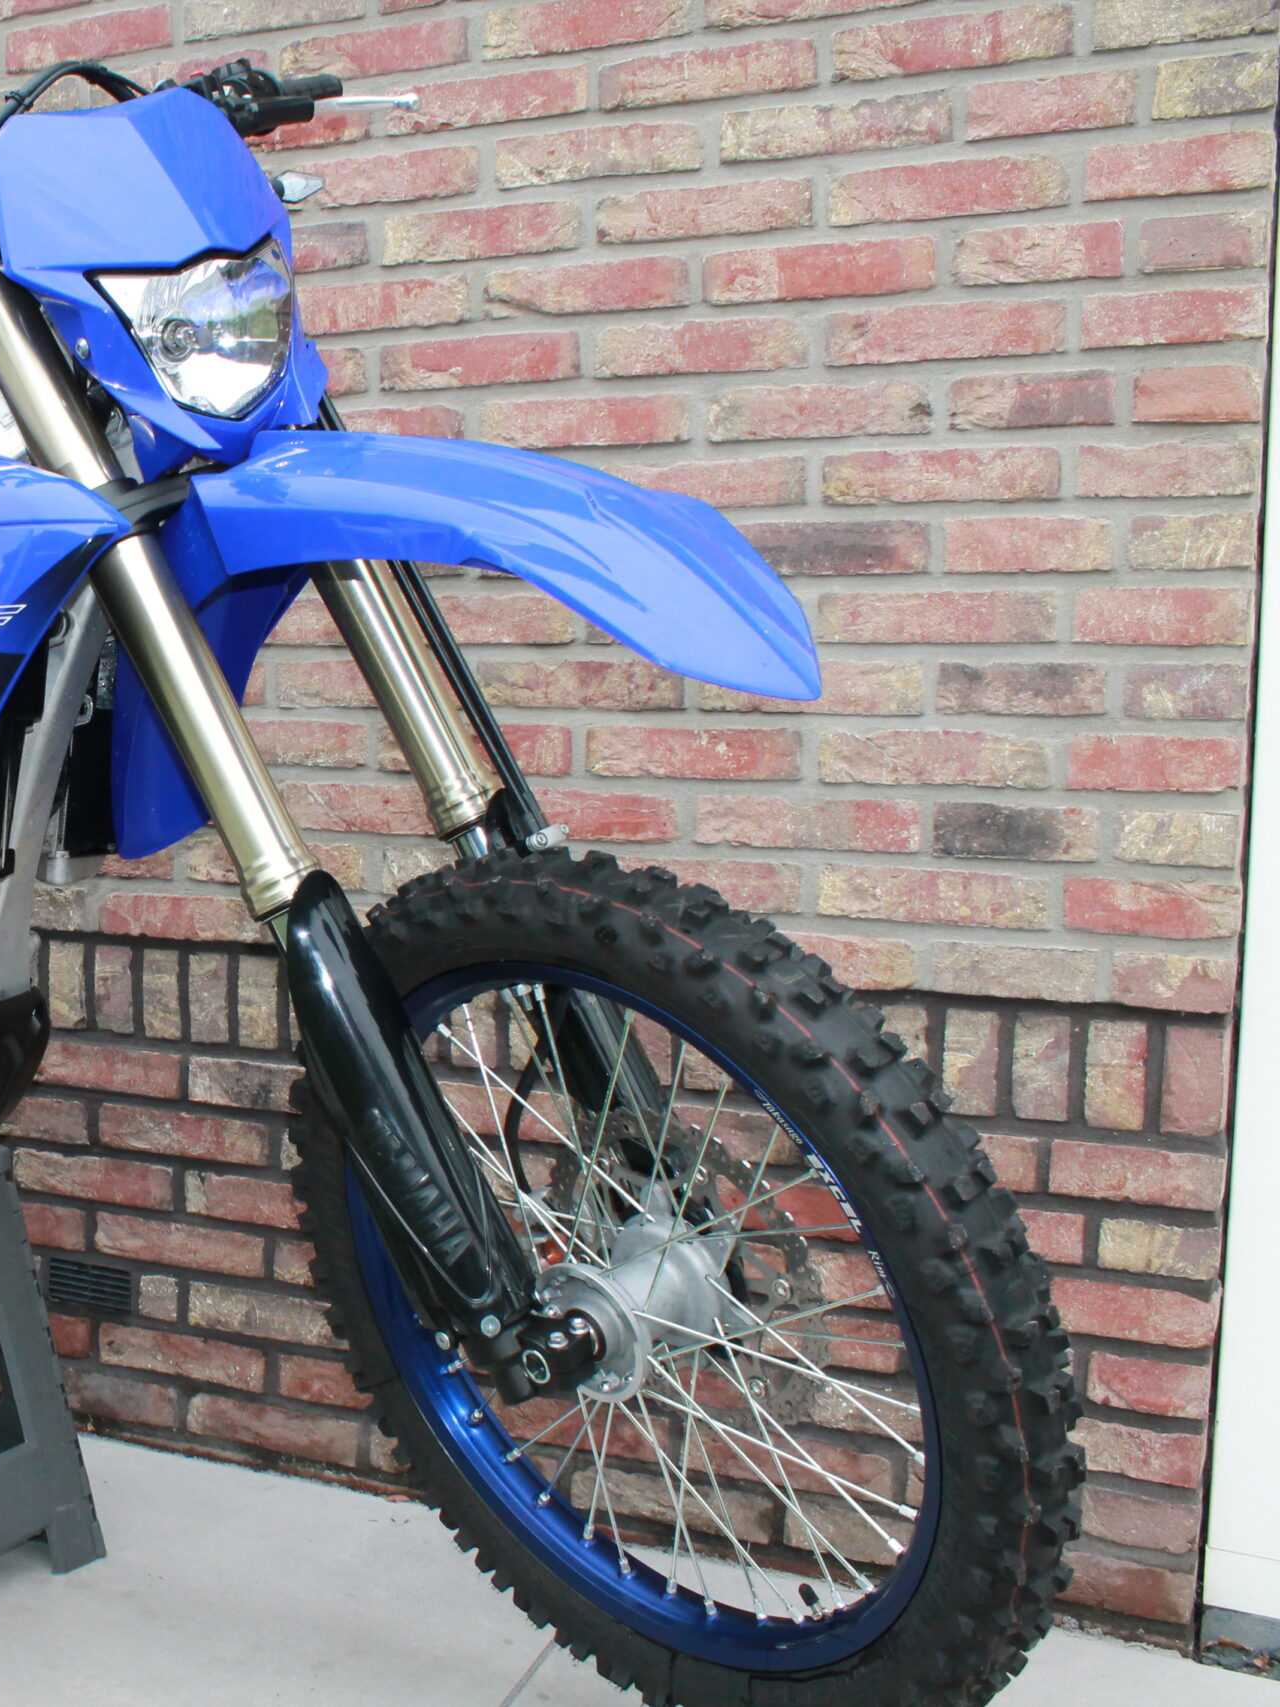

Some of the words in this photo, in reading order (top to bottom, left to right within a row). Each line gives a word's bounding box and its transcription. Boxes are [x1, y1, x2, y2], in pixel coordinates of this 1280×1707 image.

[756, 1091, 803, 1145] Takasago
[806, 1153, 863, 1234] EXCEL
[867, 1249, 889, 1283] Rim
